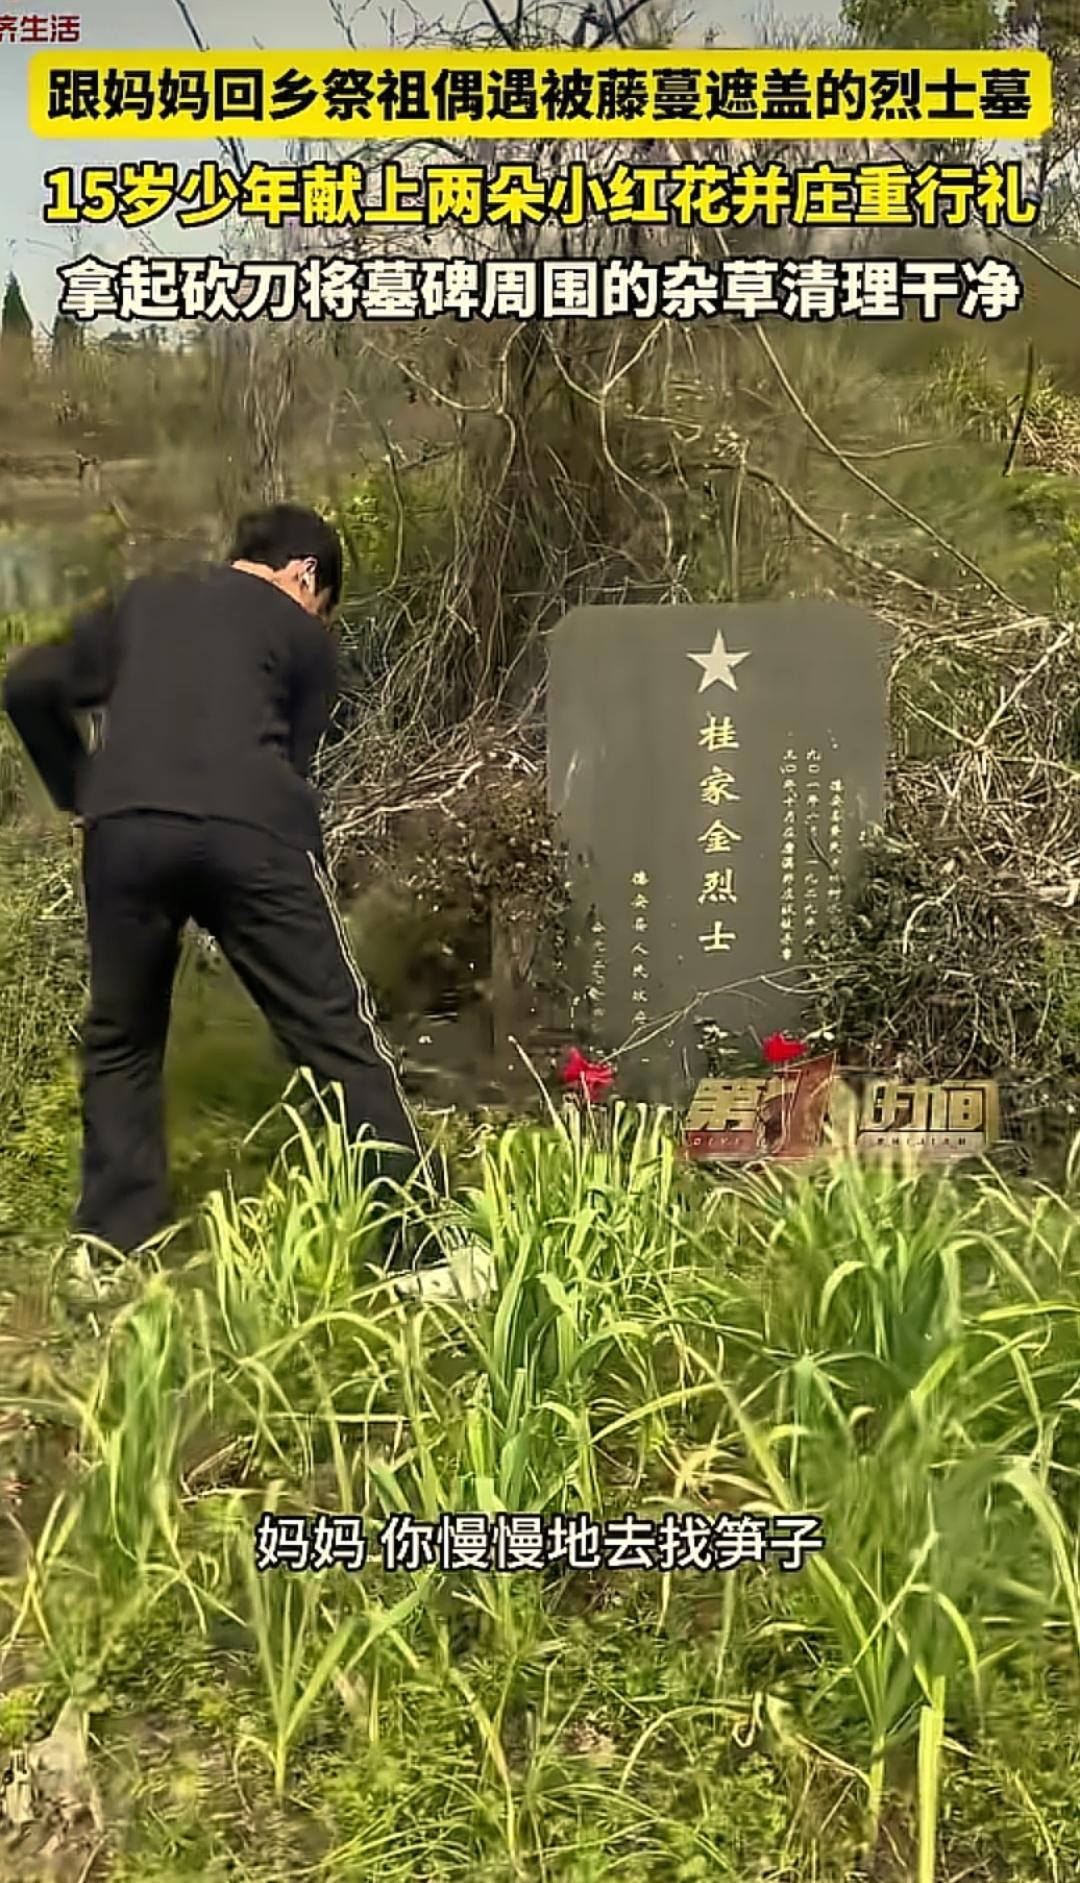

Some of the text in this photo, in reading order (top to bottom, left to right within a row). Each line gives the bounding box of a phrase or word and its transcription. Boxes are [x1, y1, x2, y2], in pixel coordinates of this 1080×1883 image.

[698, 712, 742, 953] 桂家金烈士
